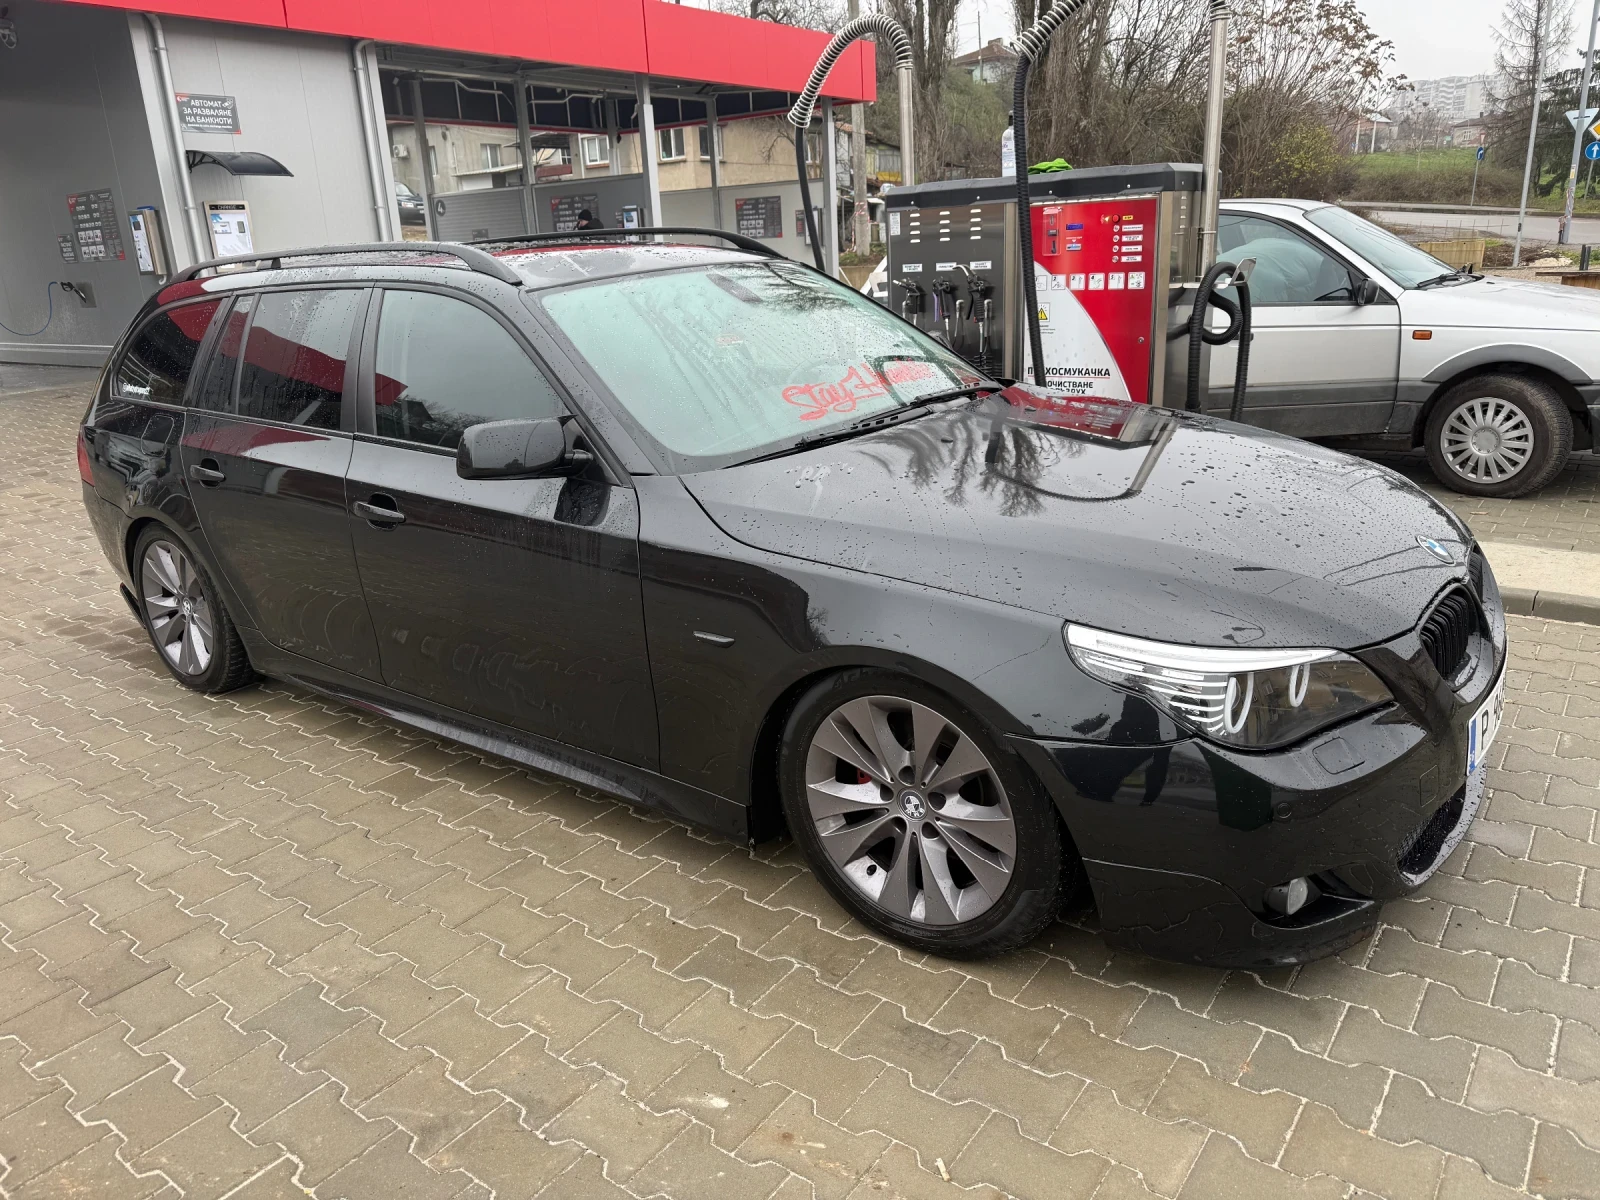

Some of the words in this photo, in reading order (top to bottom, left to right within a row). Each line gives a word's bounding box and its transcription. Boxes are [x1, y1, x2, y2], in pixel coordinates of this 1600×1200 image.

[190, 99, 222, 108] АВТОМАТ
[193, 107, 232, 117] РАЗВАЛЯНЕ
[185, 115, 196, 123] НА
[196, 116, 232, 124] БАНКНОТИ
[437, 202, 443, 213] 4
[1027, 366, 1111, 377] ПХОСМУКАЧКА
[1047, 380, 1094, 389] ОЧИСТВАНЕ
